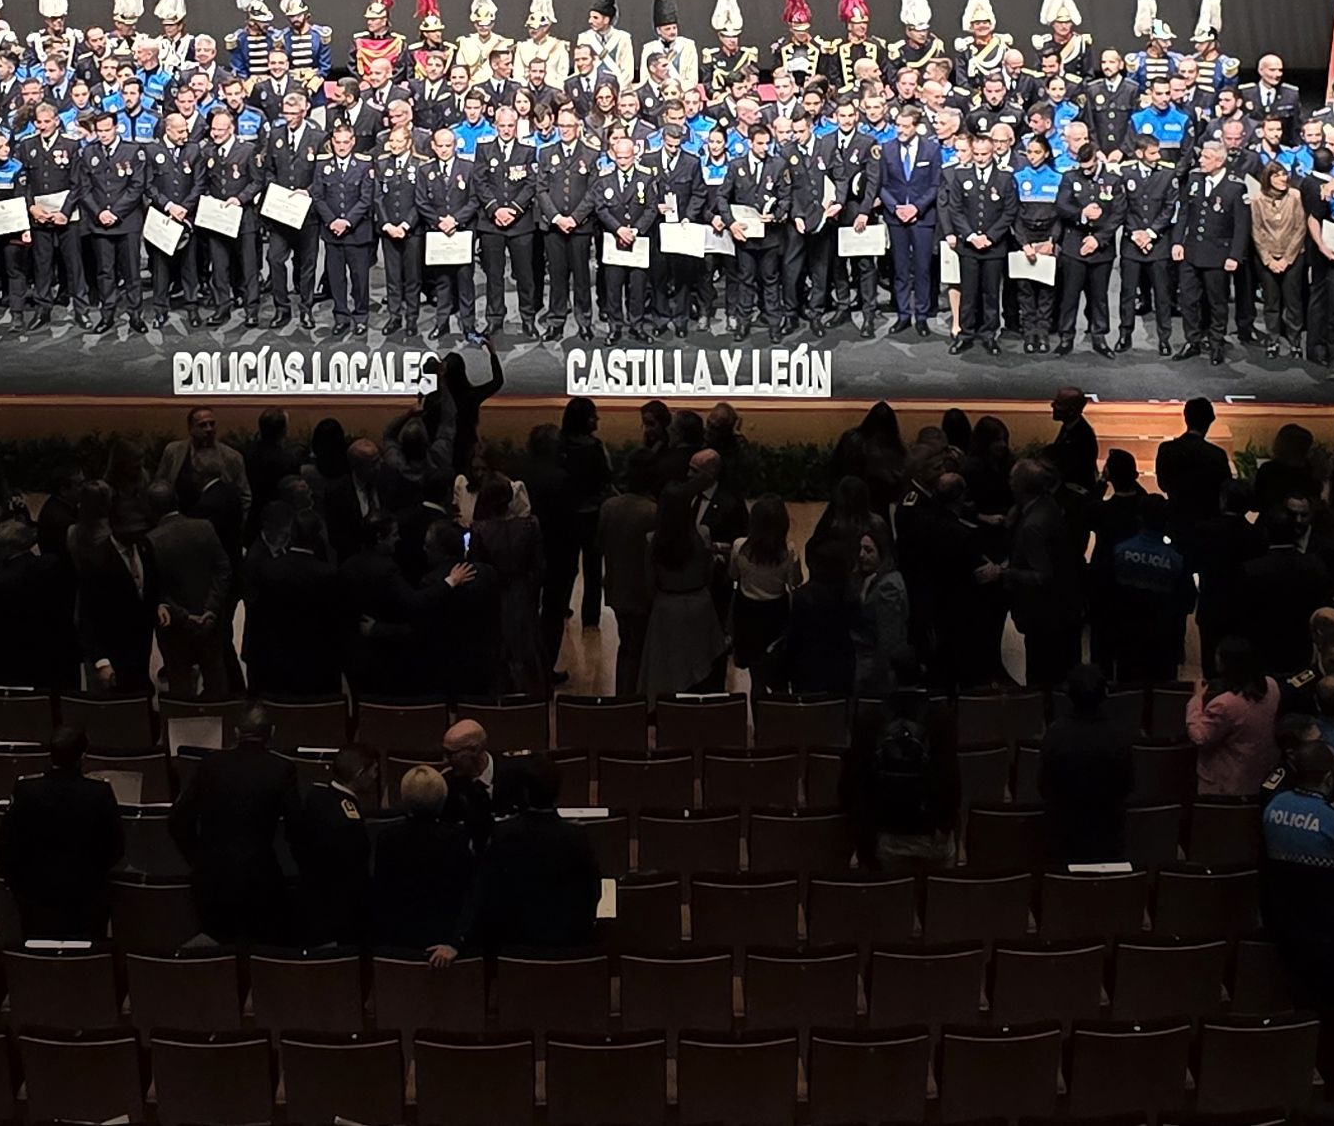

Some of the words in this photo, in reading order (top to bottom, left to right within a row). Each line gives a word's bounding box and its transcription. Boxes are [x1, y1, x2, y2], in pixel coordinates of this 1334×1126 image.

[173, 345, 305, 393] POLICÍAS
[312, 351, 442, 394] LOCALES
[567, 348, 712, 394] CASTILLA
[720, 349, 742, 393] Y
[752, 343, 832, 395] LEÓN
[1268, 809, 1320, 833] POLICÍA
